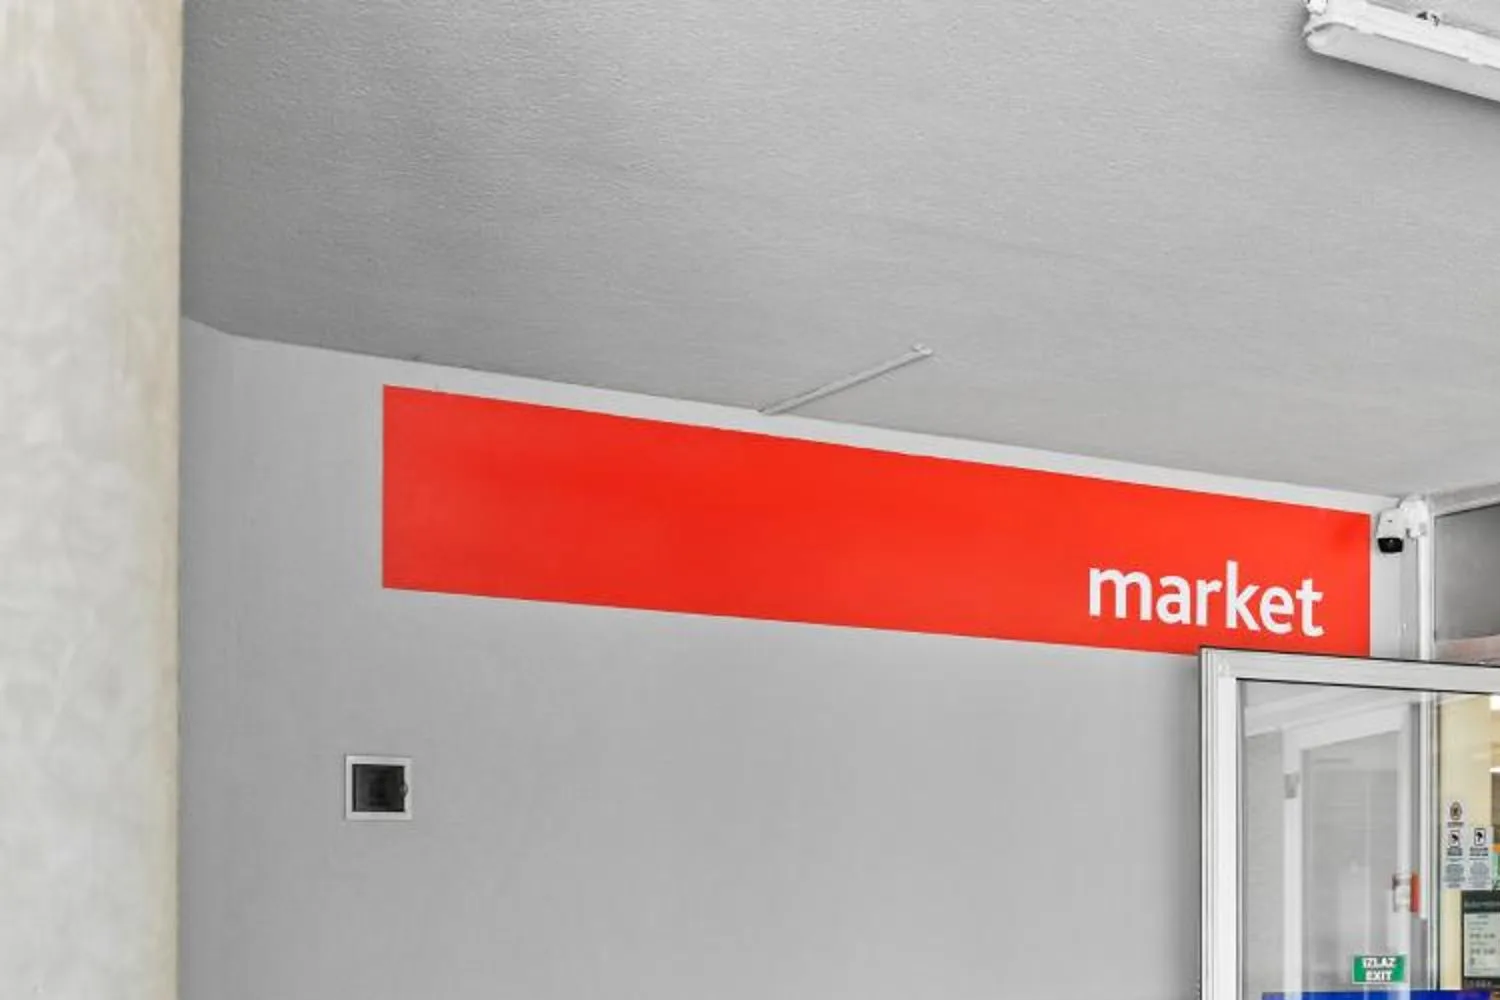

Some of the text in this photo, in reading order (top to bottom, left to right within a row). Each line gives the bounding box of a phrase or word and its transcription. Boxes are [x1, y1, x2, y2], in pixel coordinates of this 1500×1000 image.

[1088, 559, 1326, 637] market
[1362, 957, 1397, 968] IZLAZ
[1366, 971, 1392, 981] EXIT
